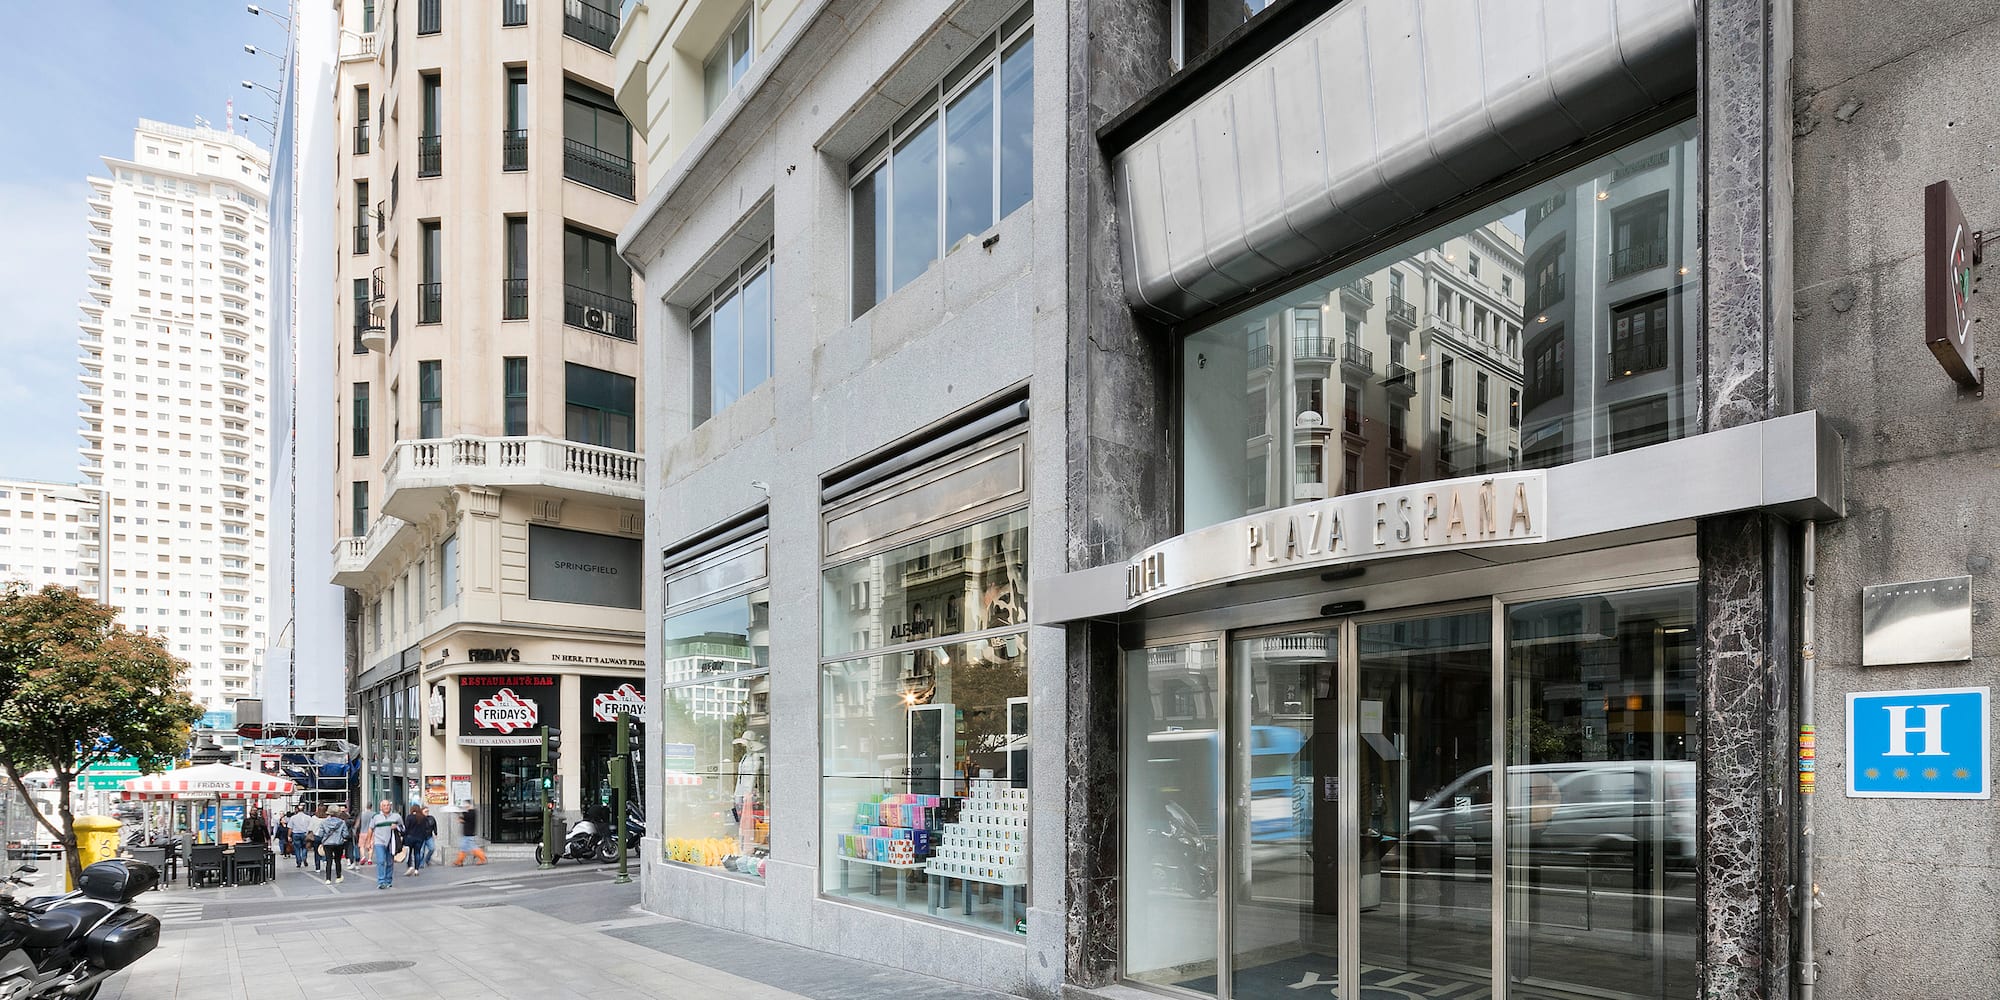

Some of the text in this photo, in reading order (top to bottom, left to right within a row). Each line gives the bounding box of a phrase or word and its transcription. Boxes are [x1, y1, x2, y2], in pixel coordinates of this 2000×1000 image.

[1247, 506, 1348, 567] PLAZA
[1373, 478, 1532, 545] ESPAÑA
[554, 560, 618, 575] SPRINGFIELD
[1881, 703, 1951, 757] H
